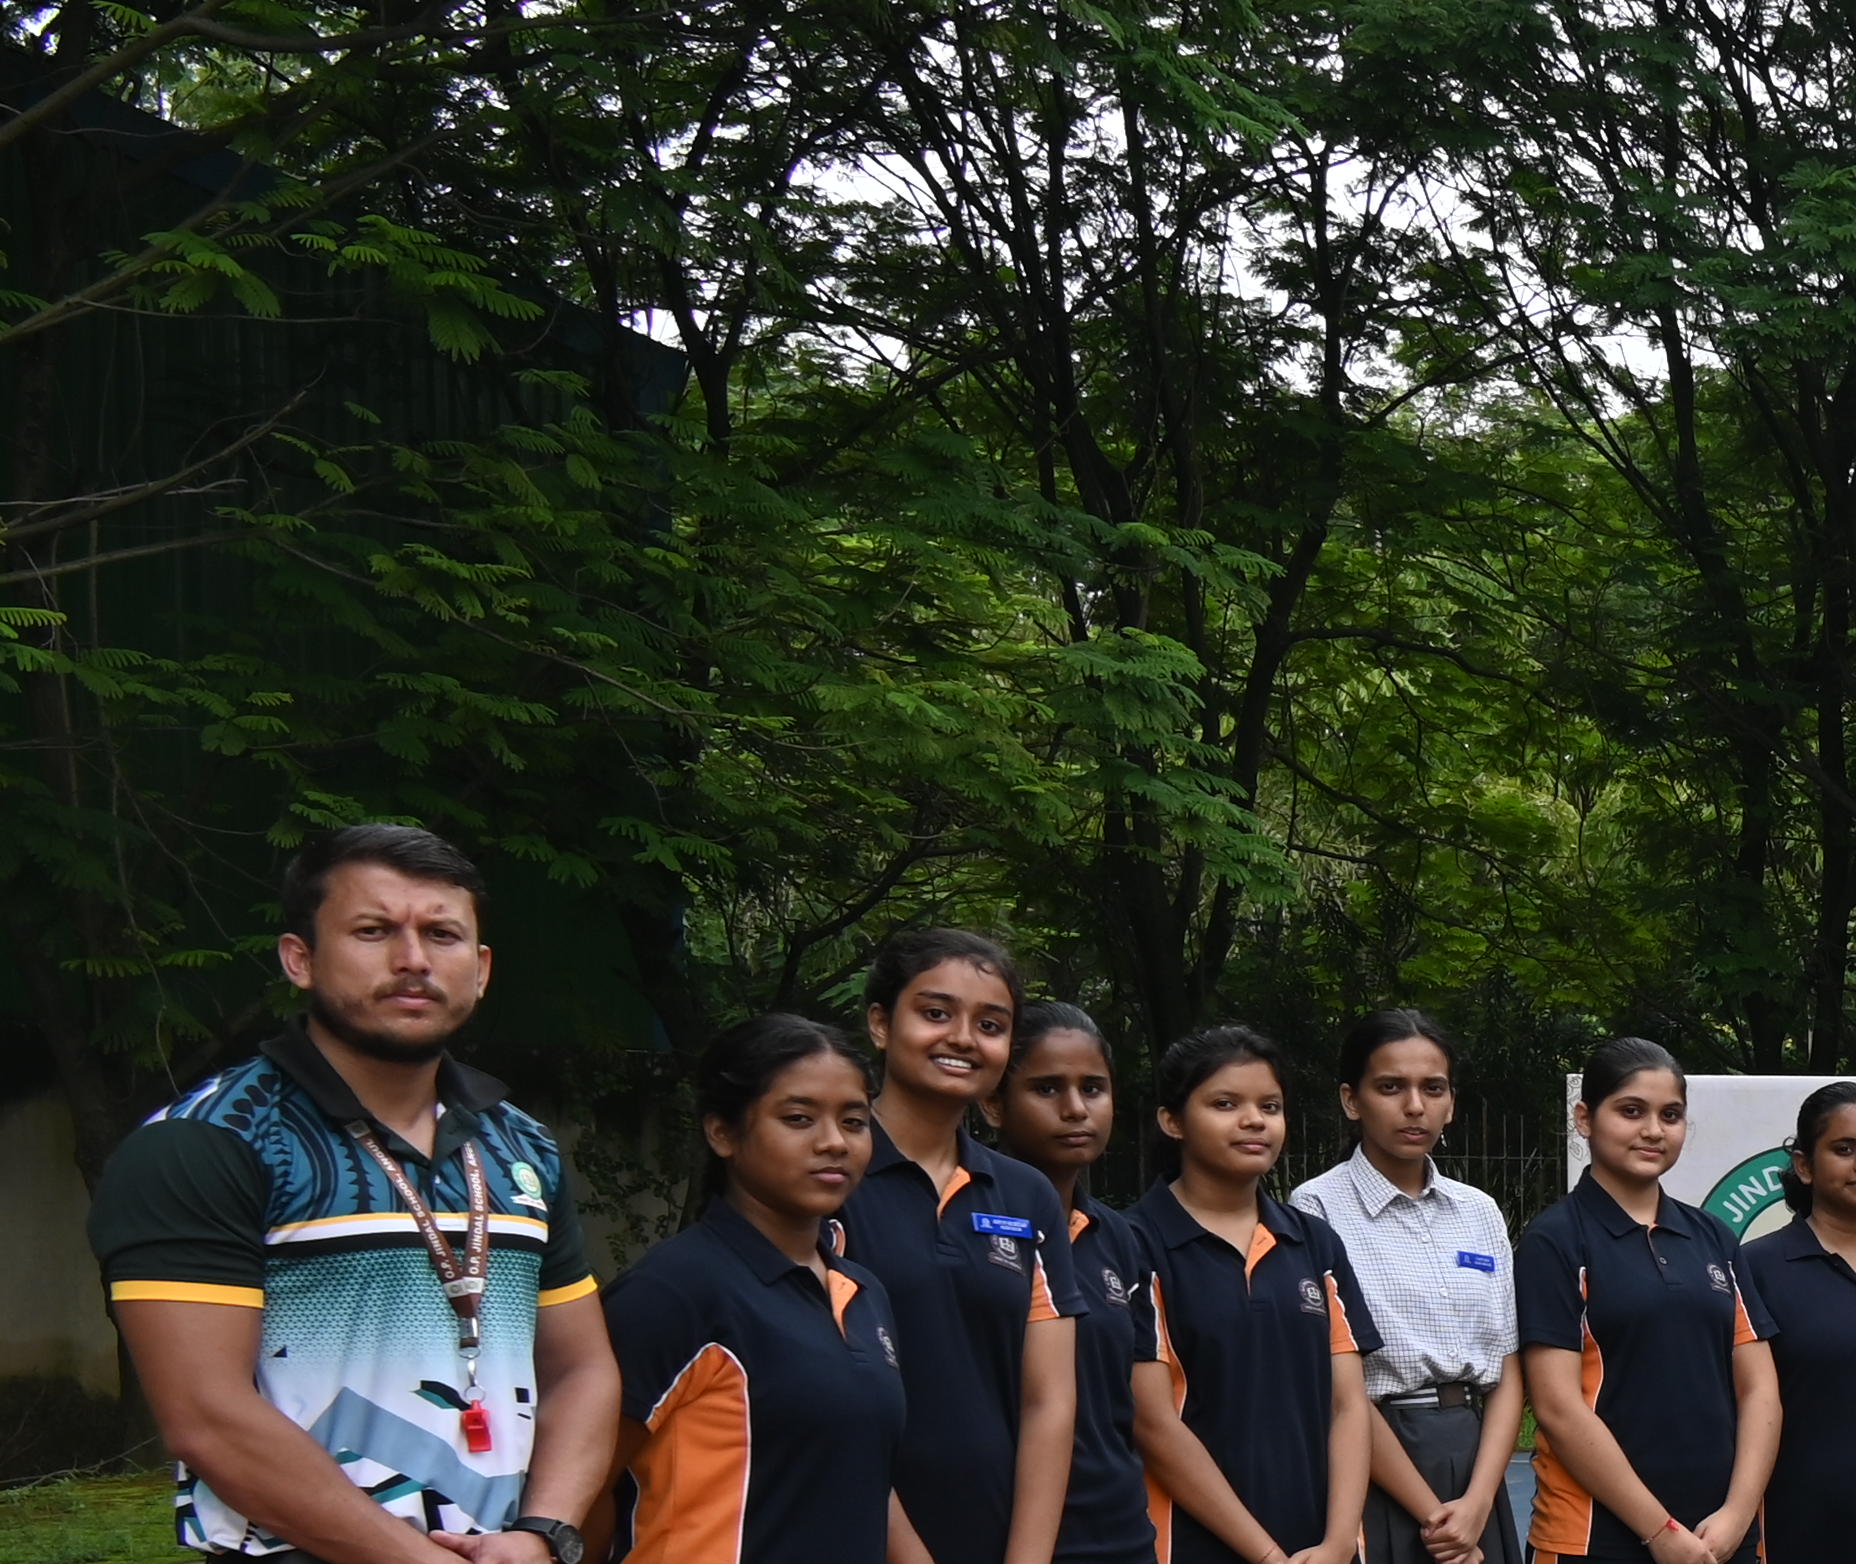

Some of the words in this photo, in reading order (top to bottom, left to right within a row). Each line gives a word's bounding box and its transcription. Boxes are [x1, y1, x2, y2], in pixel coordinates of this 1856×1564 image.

[1722, 1164, 1786, 1224] JIND
[423, 1219, 447, 1257] JINDAL
[472, 1214, 484, 1253] JINDAL
